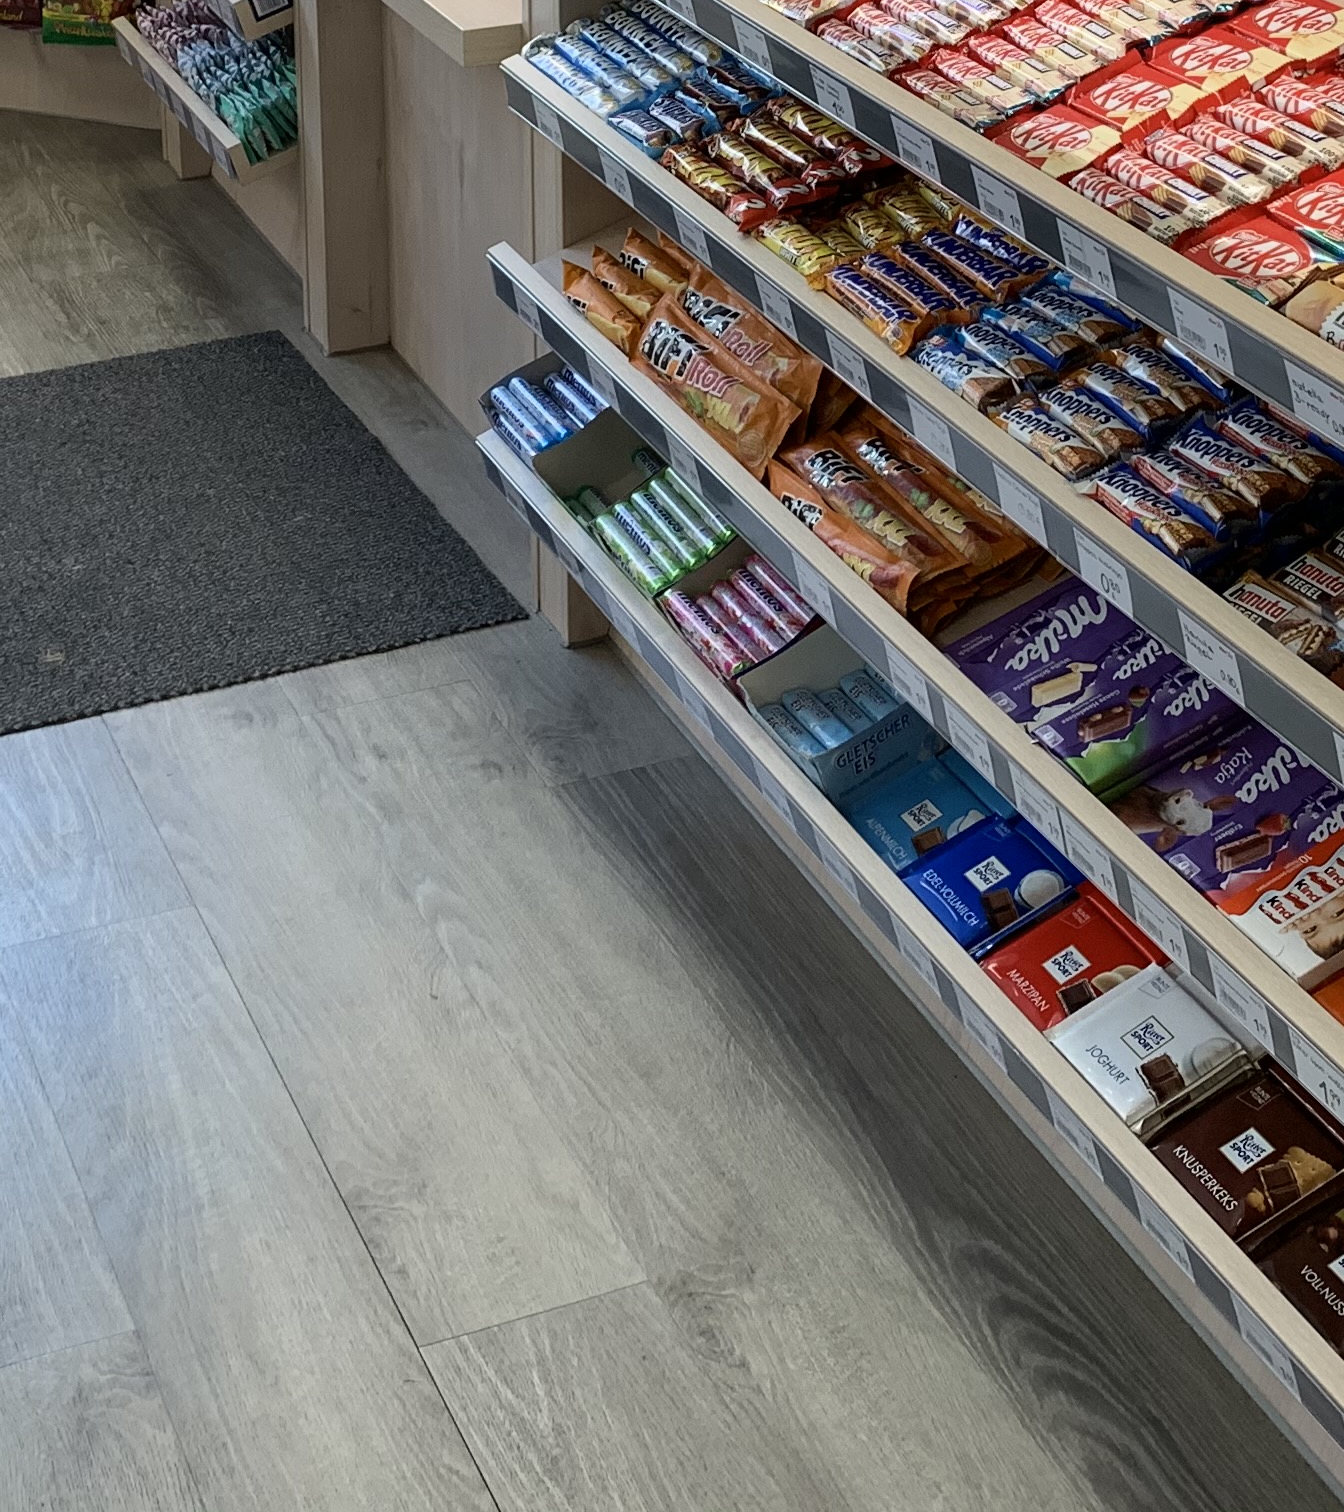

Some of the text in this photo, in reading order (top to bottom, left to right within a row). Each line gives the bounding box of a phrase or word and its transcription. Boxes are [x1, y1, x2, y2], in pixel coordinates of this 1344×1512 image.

[1172, 39, 1253, 73] KitKat
[1092, 78, 1173, 109] KitKat
[724, 330, 773, 366] Roll
[687, 356, 743, 397] Roll
[1178, 430, 1258, 468] Knoppers
[1105, 470, 1183, 518] Knoppers
[1230, 584, 1287, 622] hanuta
[1284, 574, 1320, 600] RIEGEL
[1004, 592, 1108, 672] Milka
[835, 712, 912, 770] GLETSCHER
[854, 753, 877, 775] EIS
[1214, 746, 1252, 783] Katja
[865, 817, 908, 862] ALPENMILCH
[923, 868, 979, 928] EDEL-VOLLMILCH
[1006, 968, 1050, 1013] MARZIPAN
[1085, 1044, 1130, 1086] JOGHURT
[1173, 1145, 1238, 1211] KNUSPERKEKS
